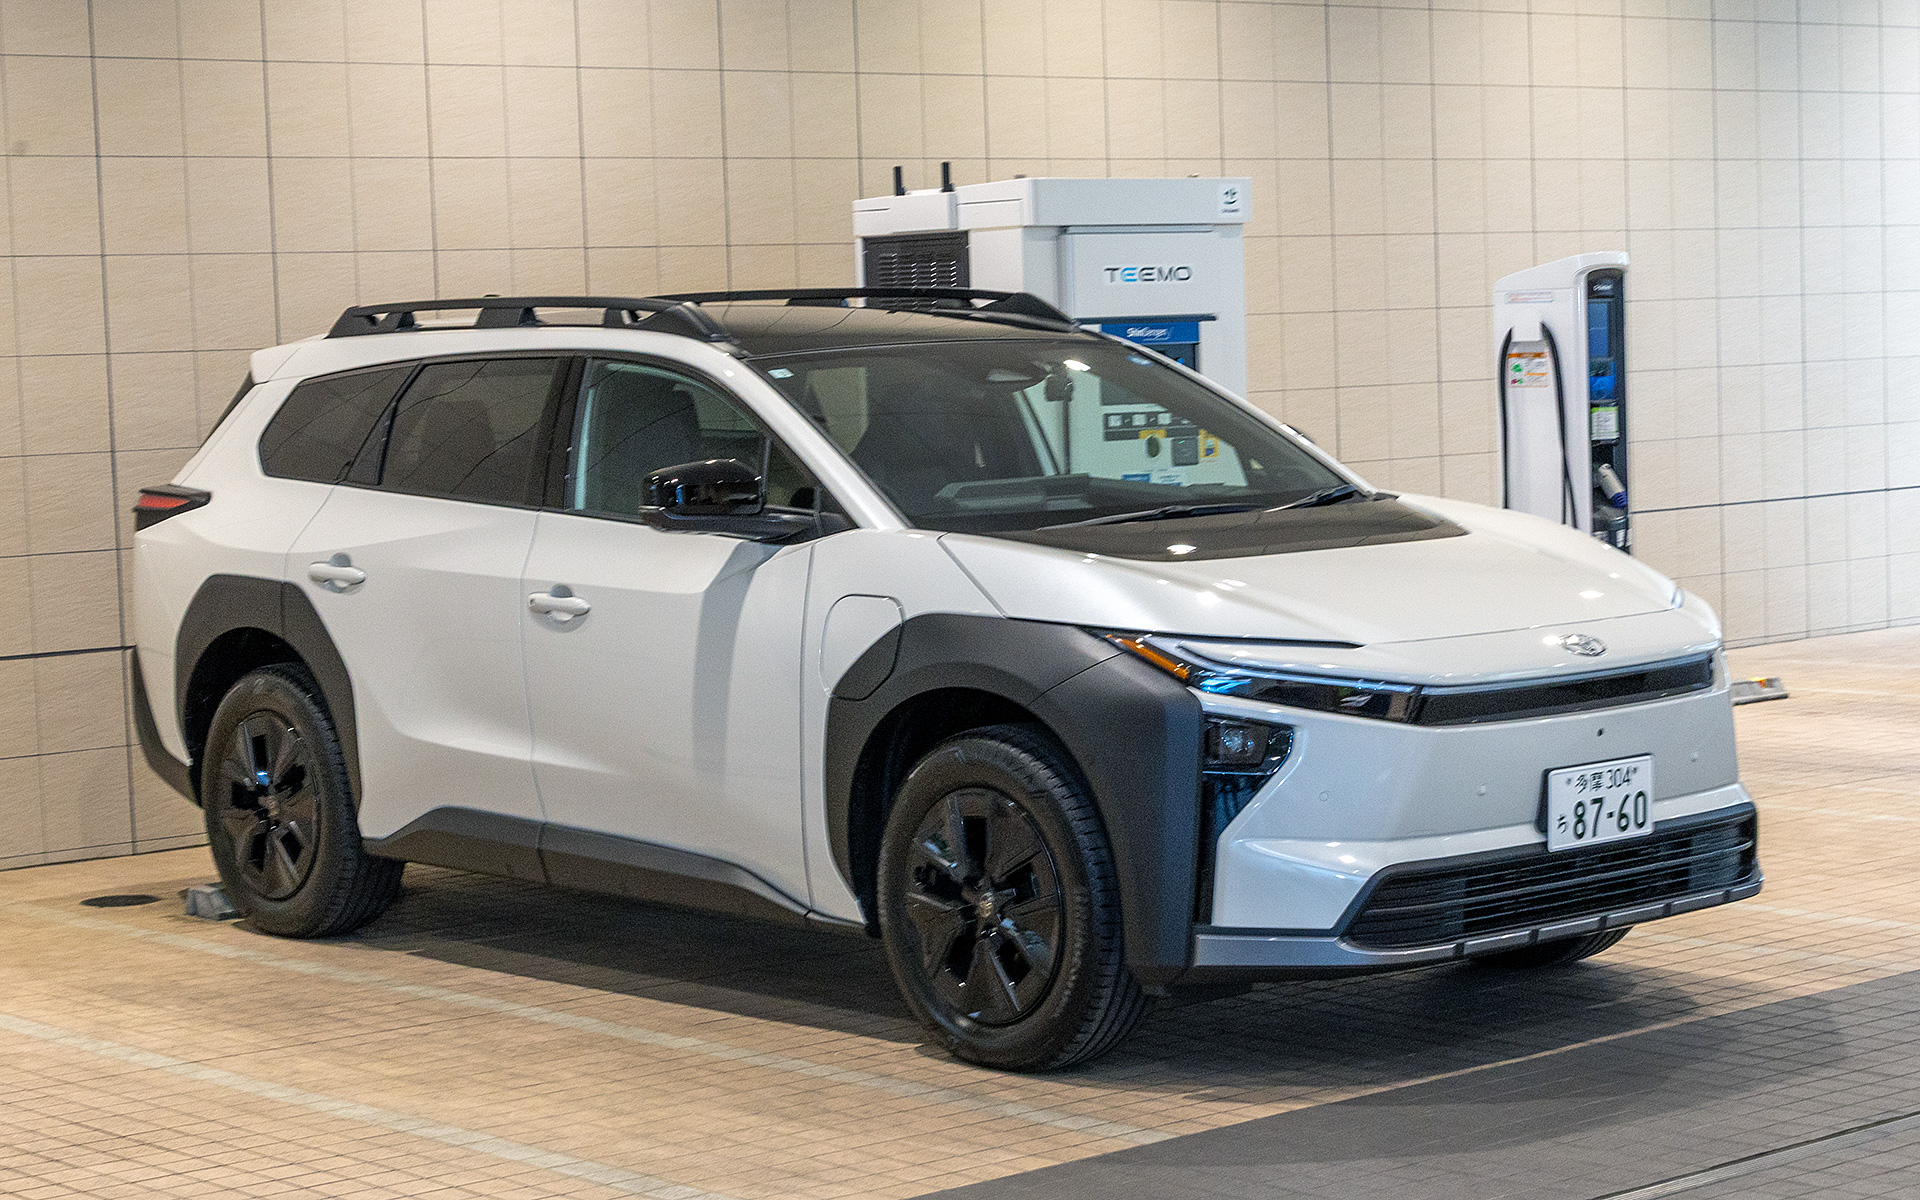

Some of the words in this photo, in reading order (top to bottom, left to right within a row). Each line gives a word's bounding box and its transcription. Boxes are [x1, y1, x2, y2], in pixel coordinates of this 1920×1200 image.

[1103, 265, 1193, 283] TEEMO
[1606, 766, 1631, 790] 304
[1573, 790, 1648, 840] 87-60
